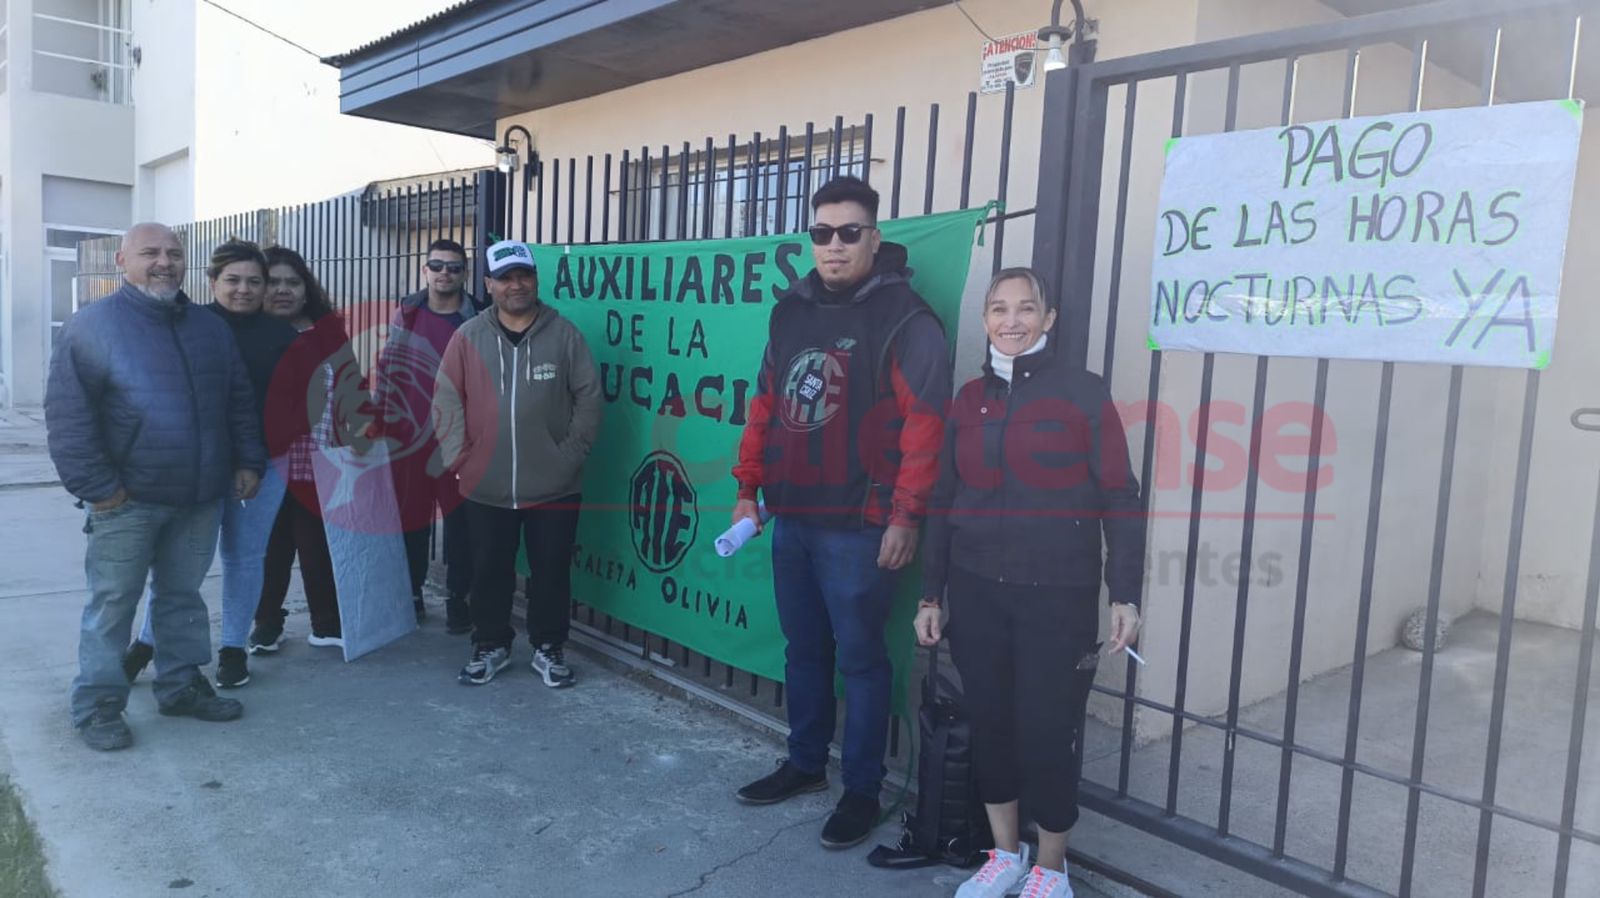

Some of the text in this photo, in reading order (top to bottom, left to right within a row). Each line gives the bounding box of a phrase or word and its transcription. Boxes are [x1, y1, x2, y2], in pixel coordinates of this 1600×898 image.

[1278, 121, 1432, 188] PAGO
[1161, 190, 1521, 257] DE LAS HORAS
[553, 243, 802, 305] AUXILIARES
[606, 309, 709, 359] DE LA
[1153, 267, 1537, 353] NOCTURNAS YA
[600, 362, 749, 426] UCACI
[661, 576, 748, 630] OLIVIA
